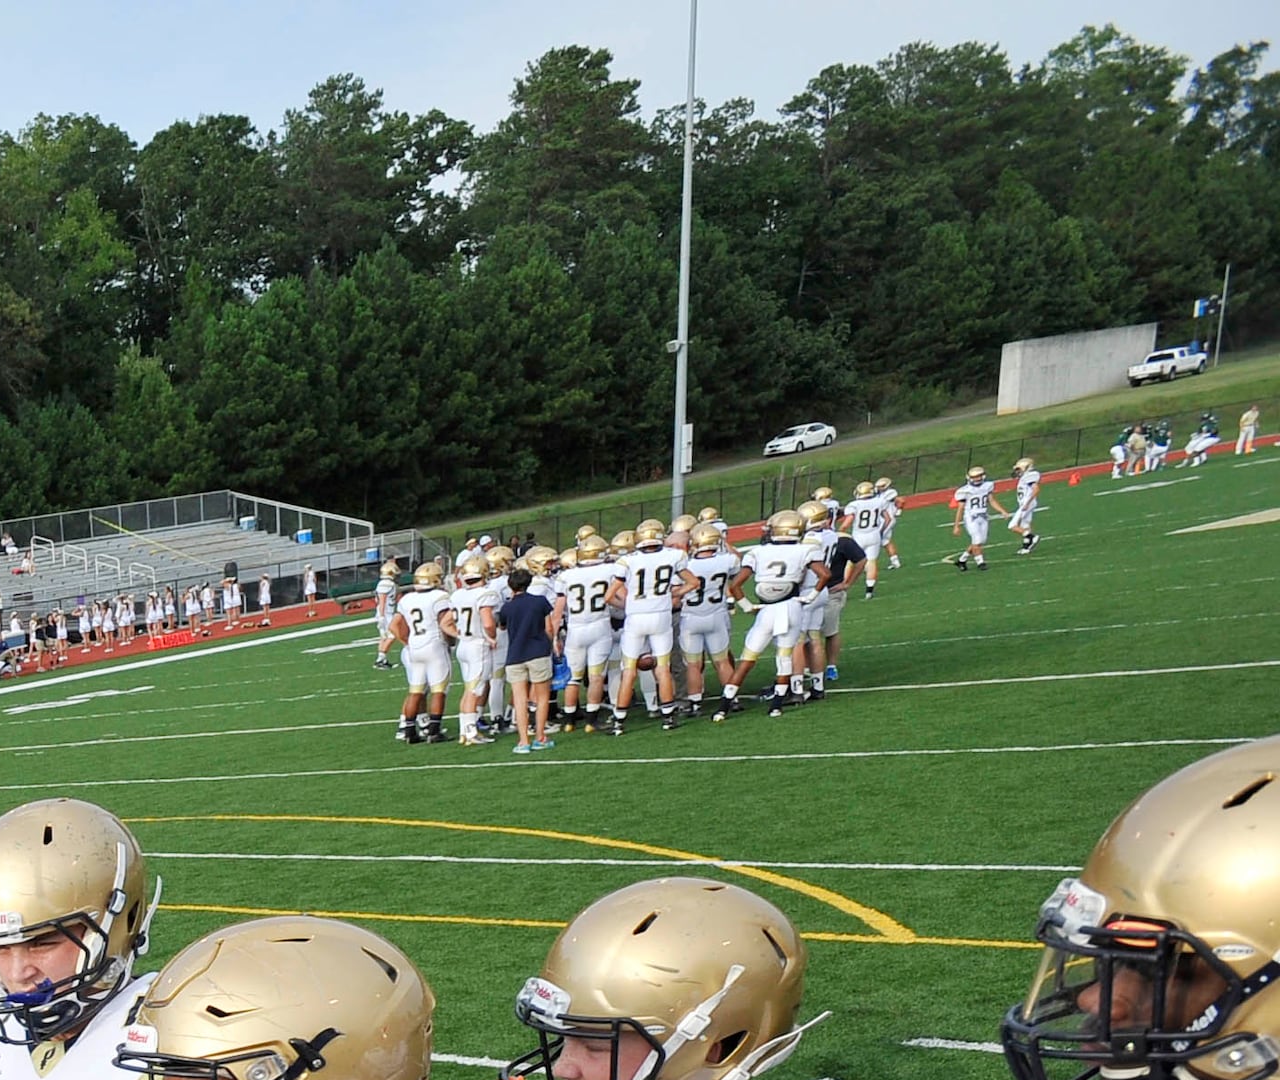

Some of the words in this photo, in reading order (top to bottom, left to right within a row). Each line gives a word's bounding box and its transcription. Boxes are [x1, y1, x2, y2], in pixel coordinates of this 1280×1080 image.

[859, 508, 880, 529] 81
[567, 580, 609, 614] 32
[634, 564, 674, 599] 18
[686, 572, 729, 607] 33
[410, 608, 426, 636] 2
